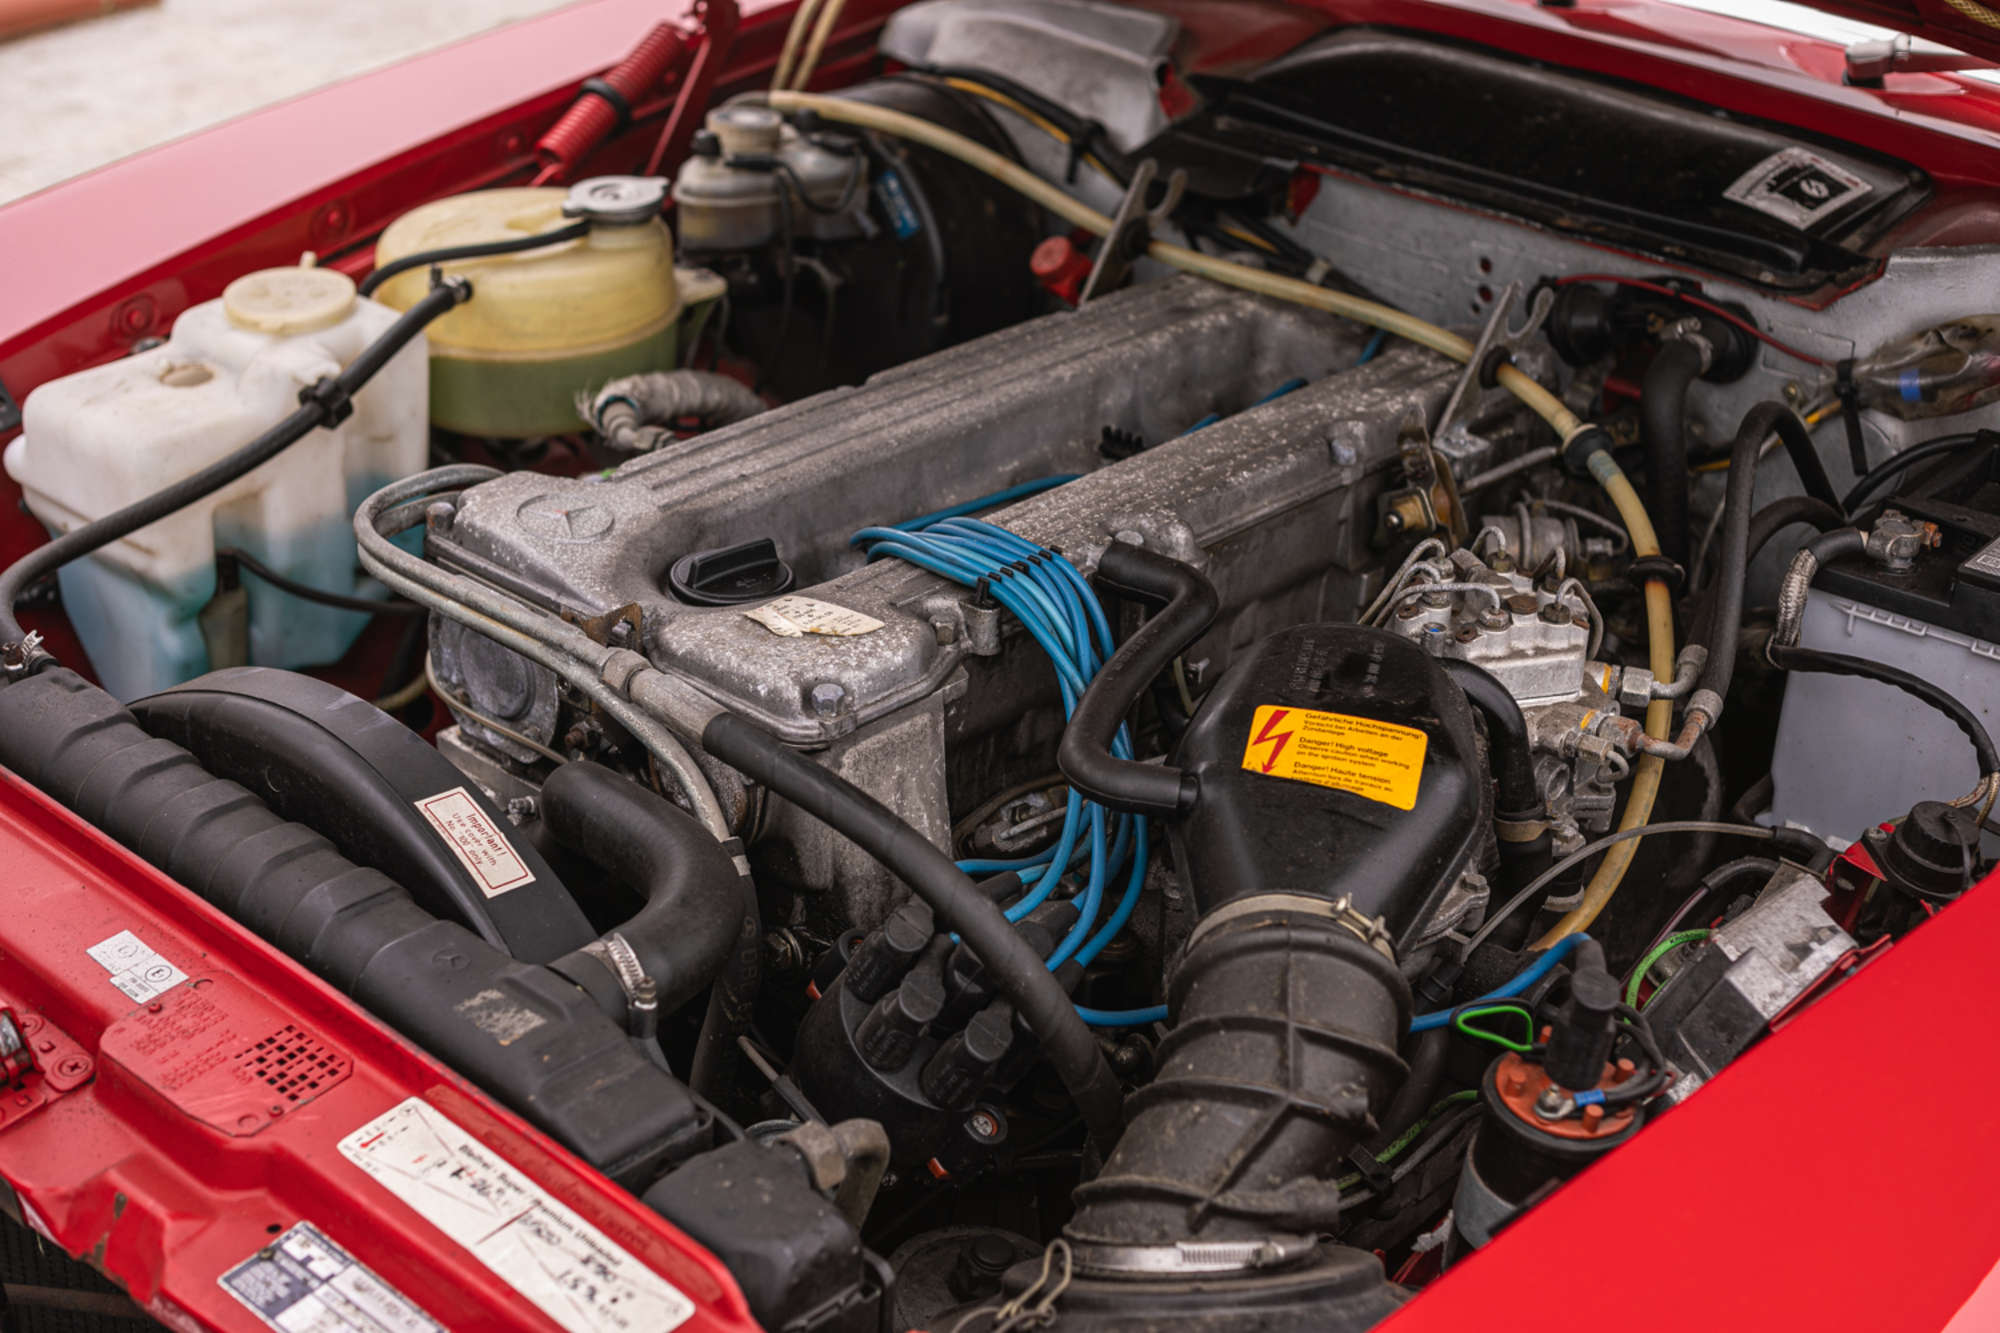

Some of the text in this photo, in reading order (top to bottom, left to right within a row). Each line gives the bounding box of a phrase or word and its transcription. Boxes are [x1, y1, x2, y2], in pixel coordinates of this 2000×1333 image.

[1299, 736, 1388, 758] Danger! High voltage
[1294, 761, 1391, 785] Danger! Haute tension
[1381, 759, 1410, 771] working
[452, 812, 497, 866] Use cover with
